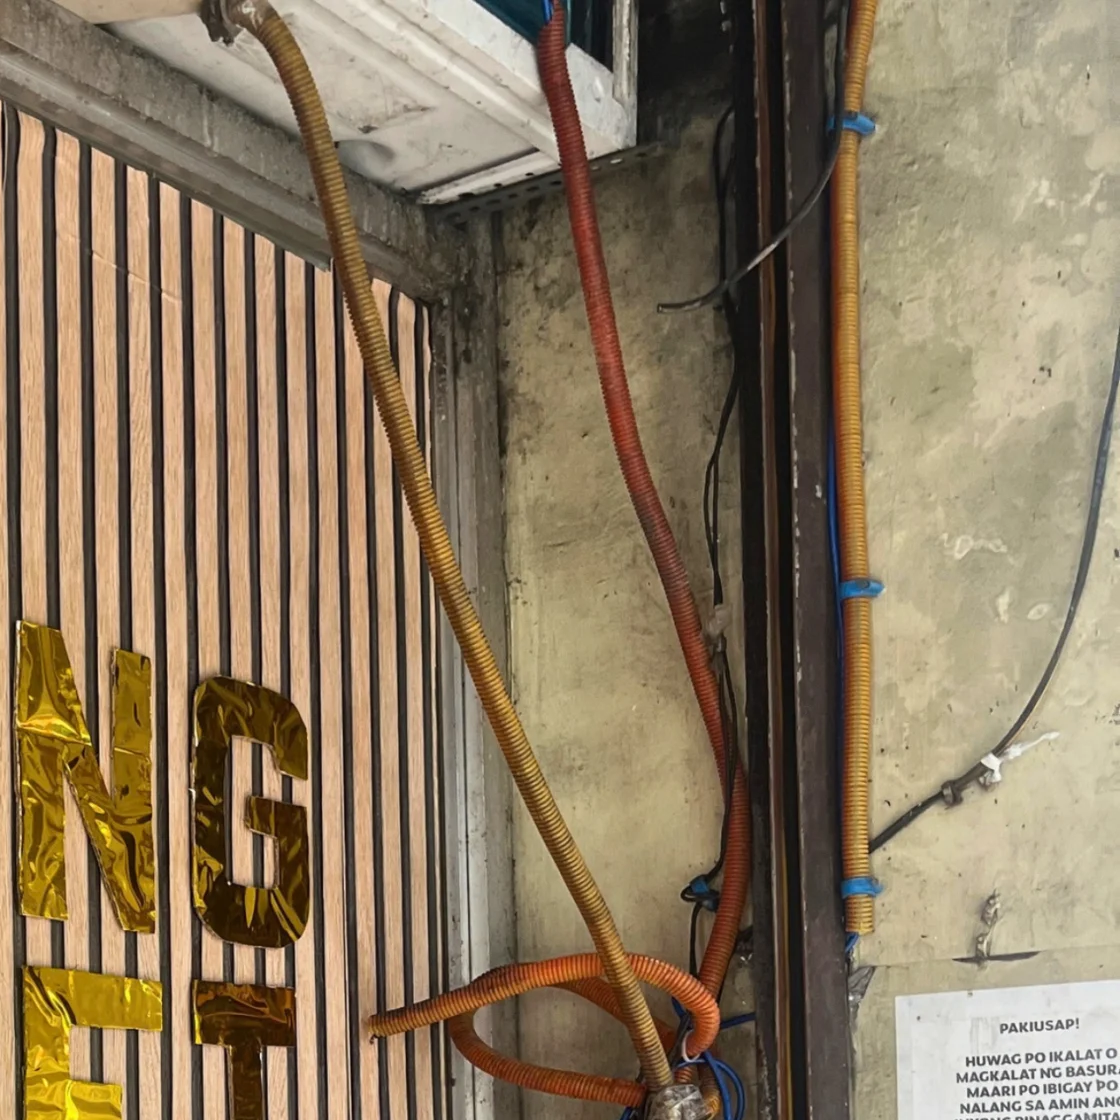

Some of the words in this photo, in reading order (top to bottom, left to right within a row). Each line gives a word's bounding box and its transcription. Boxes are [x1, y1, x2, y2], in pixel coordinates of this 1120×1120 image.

[999, 1018, 1079, 1034] PAKIUSAP!
[965, 1053, 1022, 1067] HUWAG
[1025, 1052, 1046, 1064] PO
[1049, 1049, 1102, 1062] IKALAT
[956, 1068, 1037, 1083] MAGKALAT
[1066, 1063, 1120, 1078] BASUR
[967, 1085, 1016, 1098] MAARI
[1019, 1084, 1040, 1096] PO
[1043, 1081, 1093, 1095] IBIGAY
[1096, 1079, 1118, 1092] PO
[960, 1101, 1022, 1114] NALANG
[1025, 1099, 1045, 1111] SA
[1048, 1097, 1089, 1110] AMIN
